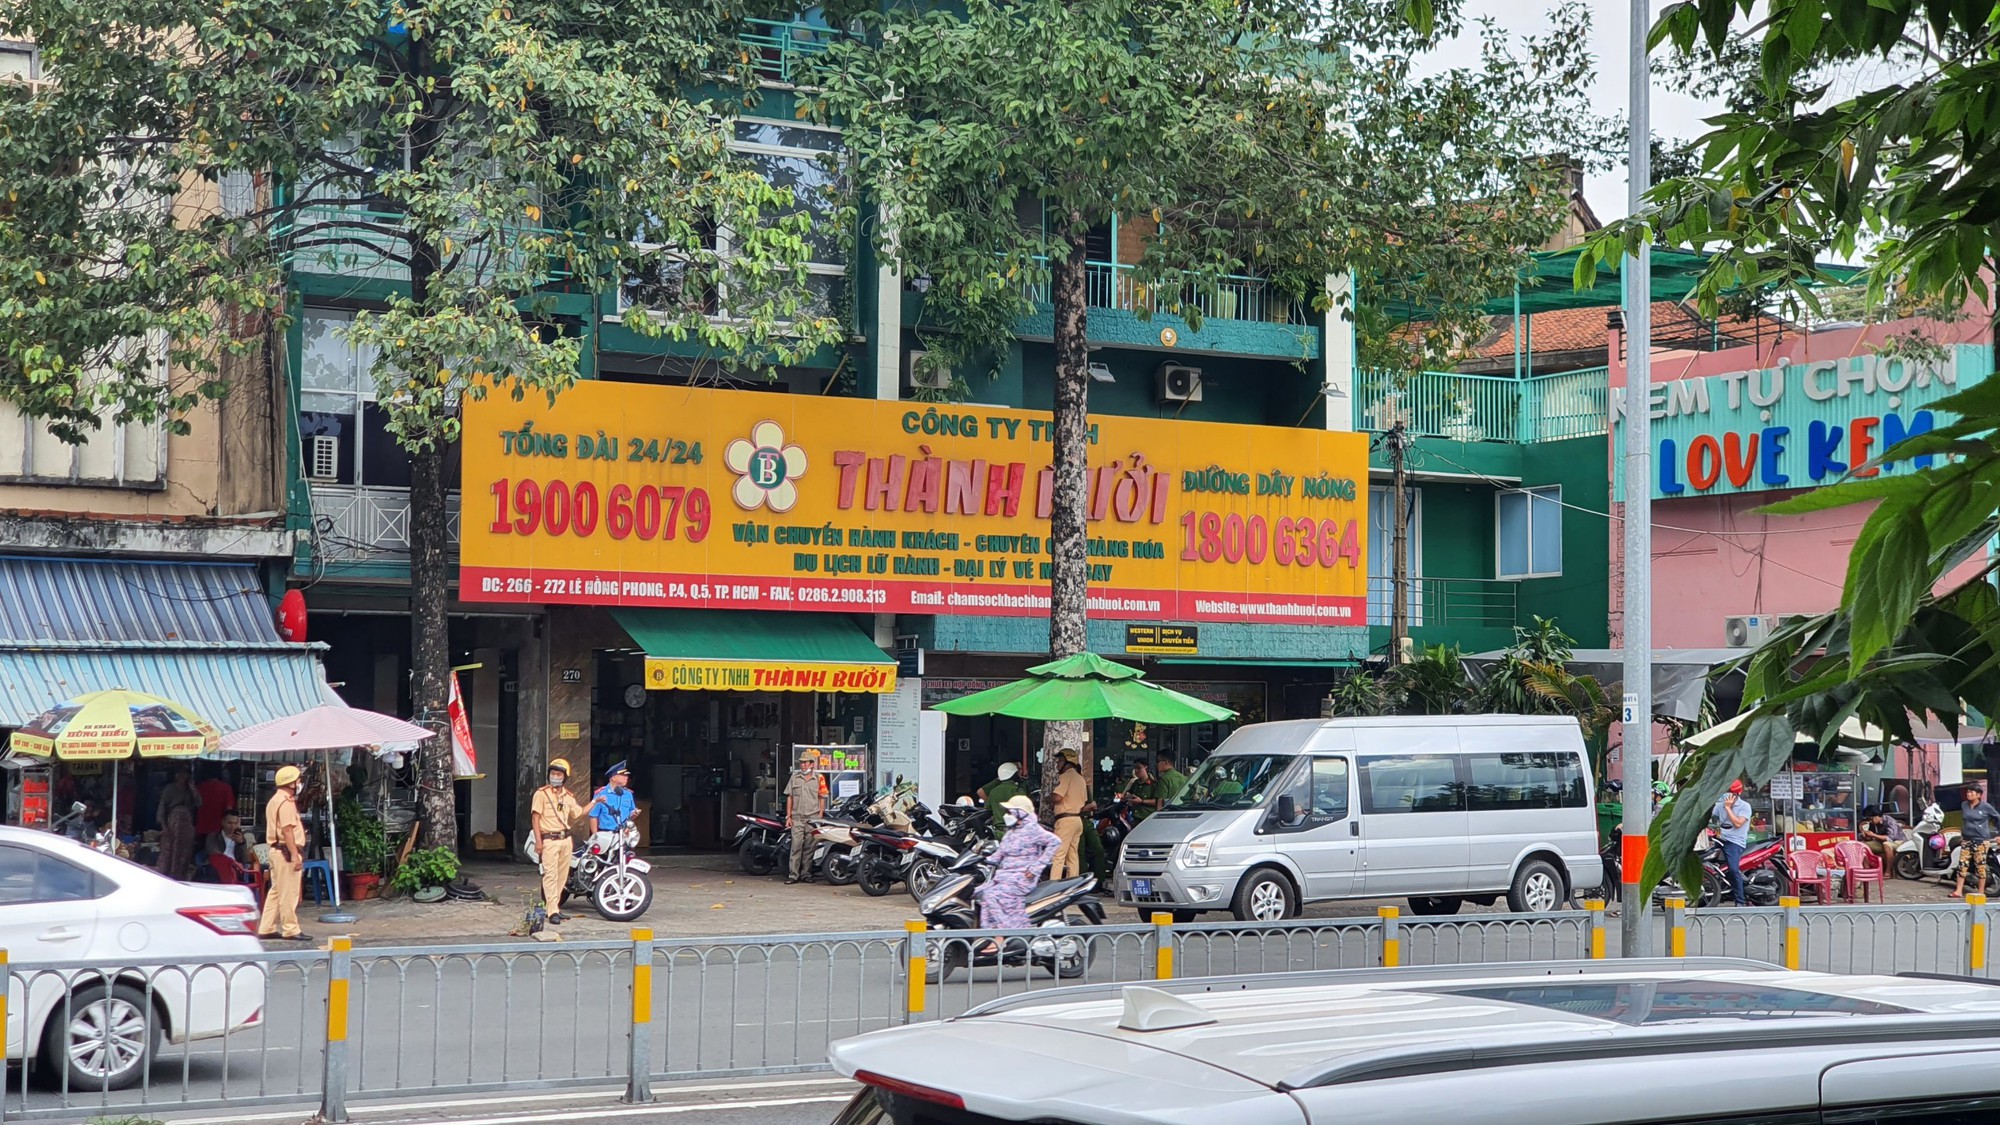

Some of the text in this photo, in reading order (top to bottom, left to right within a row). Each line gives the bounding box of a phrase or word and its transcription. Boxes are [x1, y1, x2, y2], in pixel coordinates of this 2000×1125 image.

[1721, 356, 1791, 422] TỰ
[1803, 343, 1957, 409] CHỌN
[500, 420, 703, 464] TỔNG ĐÀI 24/24
[902, 408, 1099, 445] CÔNG TY TH
[1659, 410, 1934, 494] LOVE KEM
[833, 443, 1026, 517] THÀNH
[1182, 464, 1356, 501] ĐƯỜNG DÂY NÓNG
[489, 478, 711, 543] 1900 6079
[732, 520, 770, 547] VẬN
[849, 525, 896, 548] HÀNH
[902, 528, 959, 551] KHÁCH
[1133, 538, 1164, 559] HÓA
[1180, 510, 1361, 568] 1800 6364
[793, 552, 818, 572] DU
[824, 554, 862, 576] LỊCH
[893, 554, 940, 576] HÀNH
[954, 559, 983, 582] ĐẠI
[989, 557, 1007, 578] LÝ
[1013, 558, 1034, 579] VÉ
[507, 578, 532, 593] 266
[544, 579, 565, 594] 272
[569, 577, 581, 594] LÊ
[584, 575, 618, 595] HỒNG
[622, 583, 666, 598] PHONG,
[669, 583, 688, 598] P.4,
[690, 584, 711, 599] Q.5,
[714, 585, 729, 599] TP.
[732, 585, 759, 600] HCM
[770, 586, 794, 601] FAX:
[798, 587, 886, 604] 0286.2.908.313
[911, 590, 945, 605] Email:
[1195, 600, 1352, 617] Website: www.thanhbuoi.com.vn
[563, 670, 580, 679] 270
[672, 663, 887, 688] CÔNG TY TNHH THÀNH BƯỞI
[1625, 708, 1632, 721] 3
